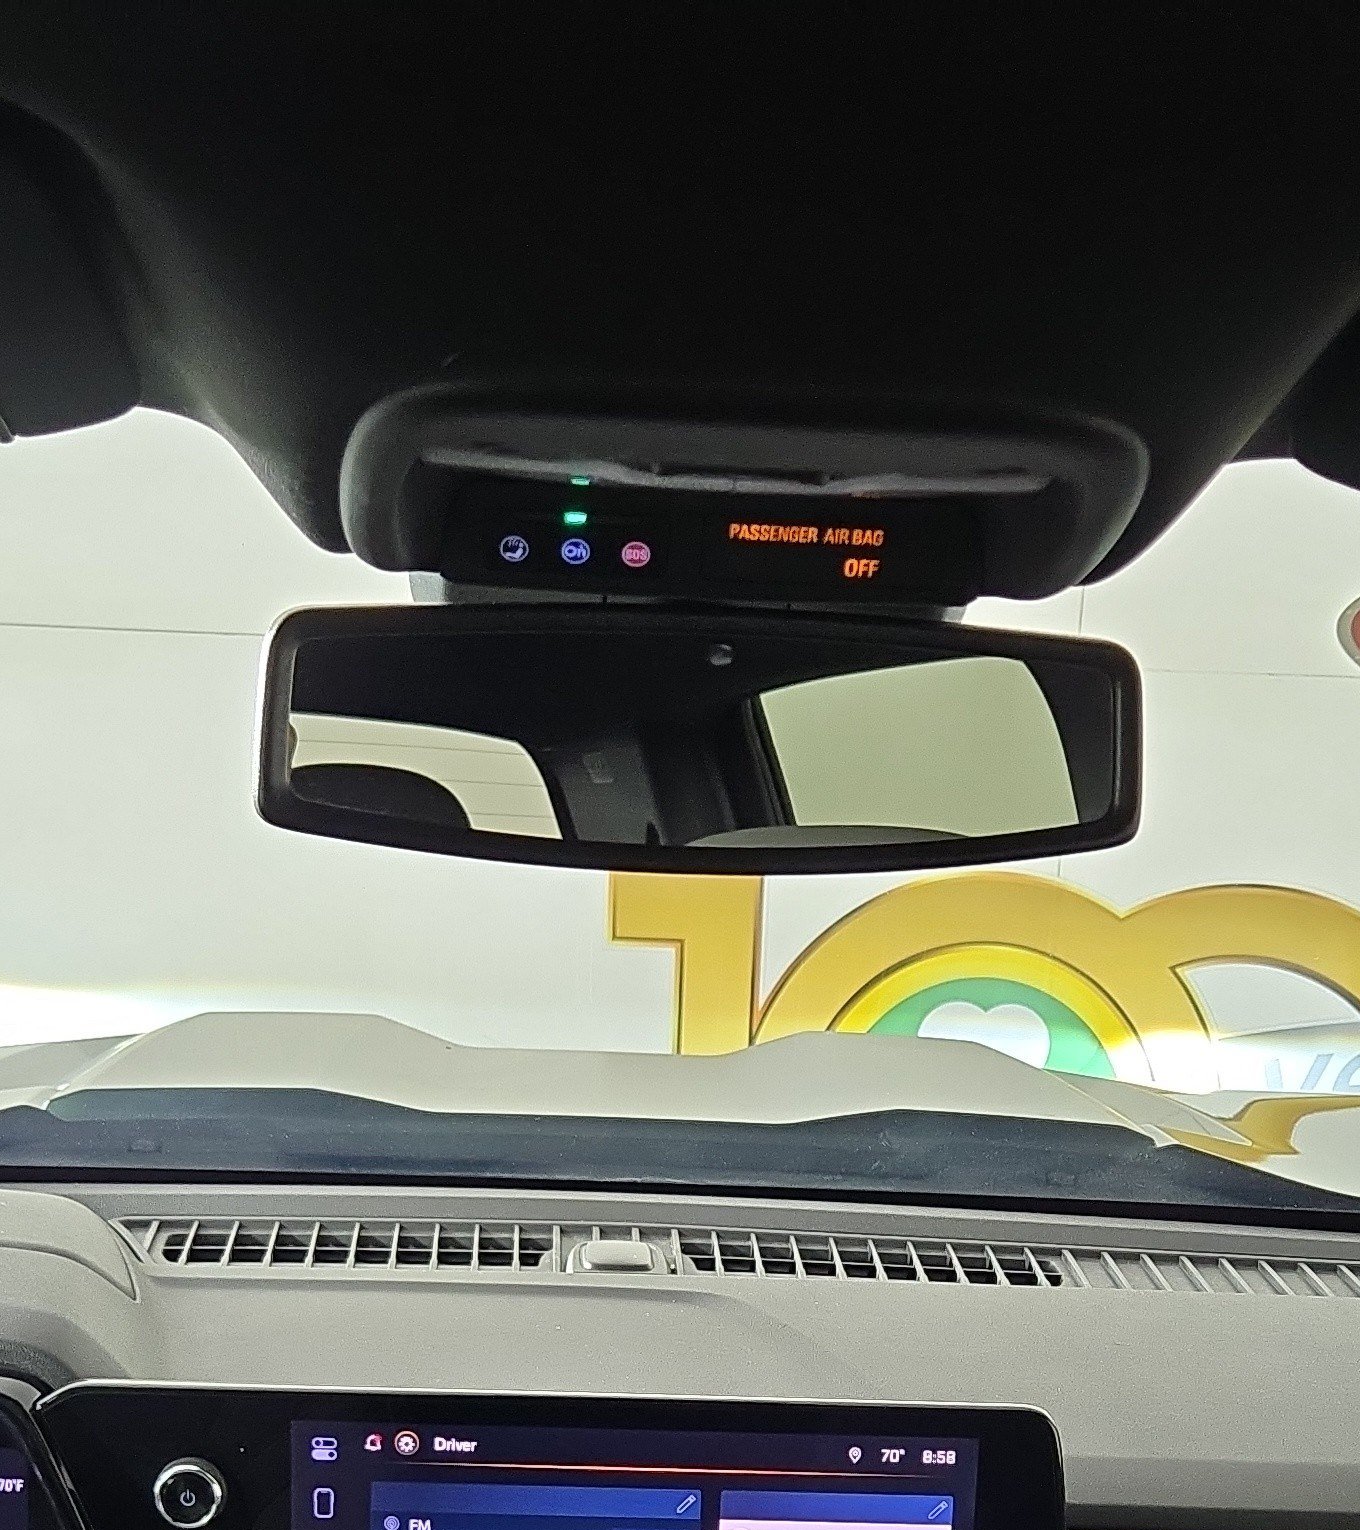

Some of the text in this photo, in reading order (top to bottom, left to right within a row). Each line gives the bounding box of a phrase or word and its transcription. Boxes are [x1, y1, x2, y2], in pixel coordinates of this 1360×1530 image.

[728, 523, 885, 546] PASSENGER AIR BAG
[843, 557, 881, 578] OFF
[434, 1437, 478, 1452] Driver
[922, 1449, 957, 1465] 8:58
